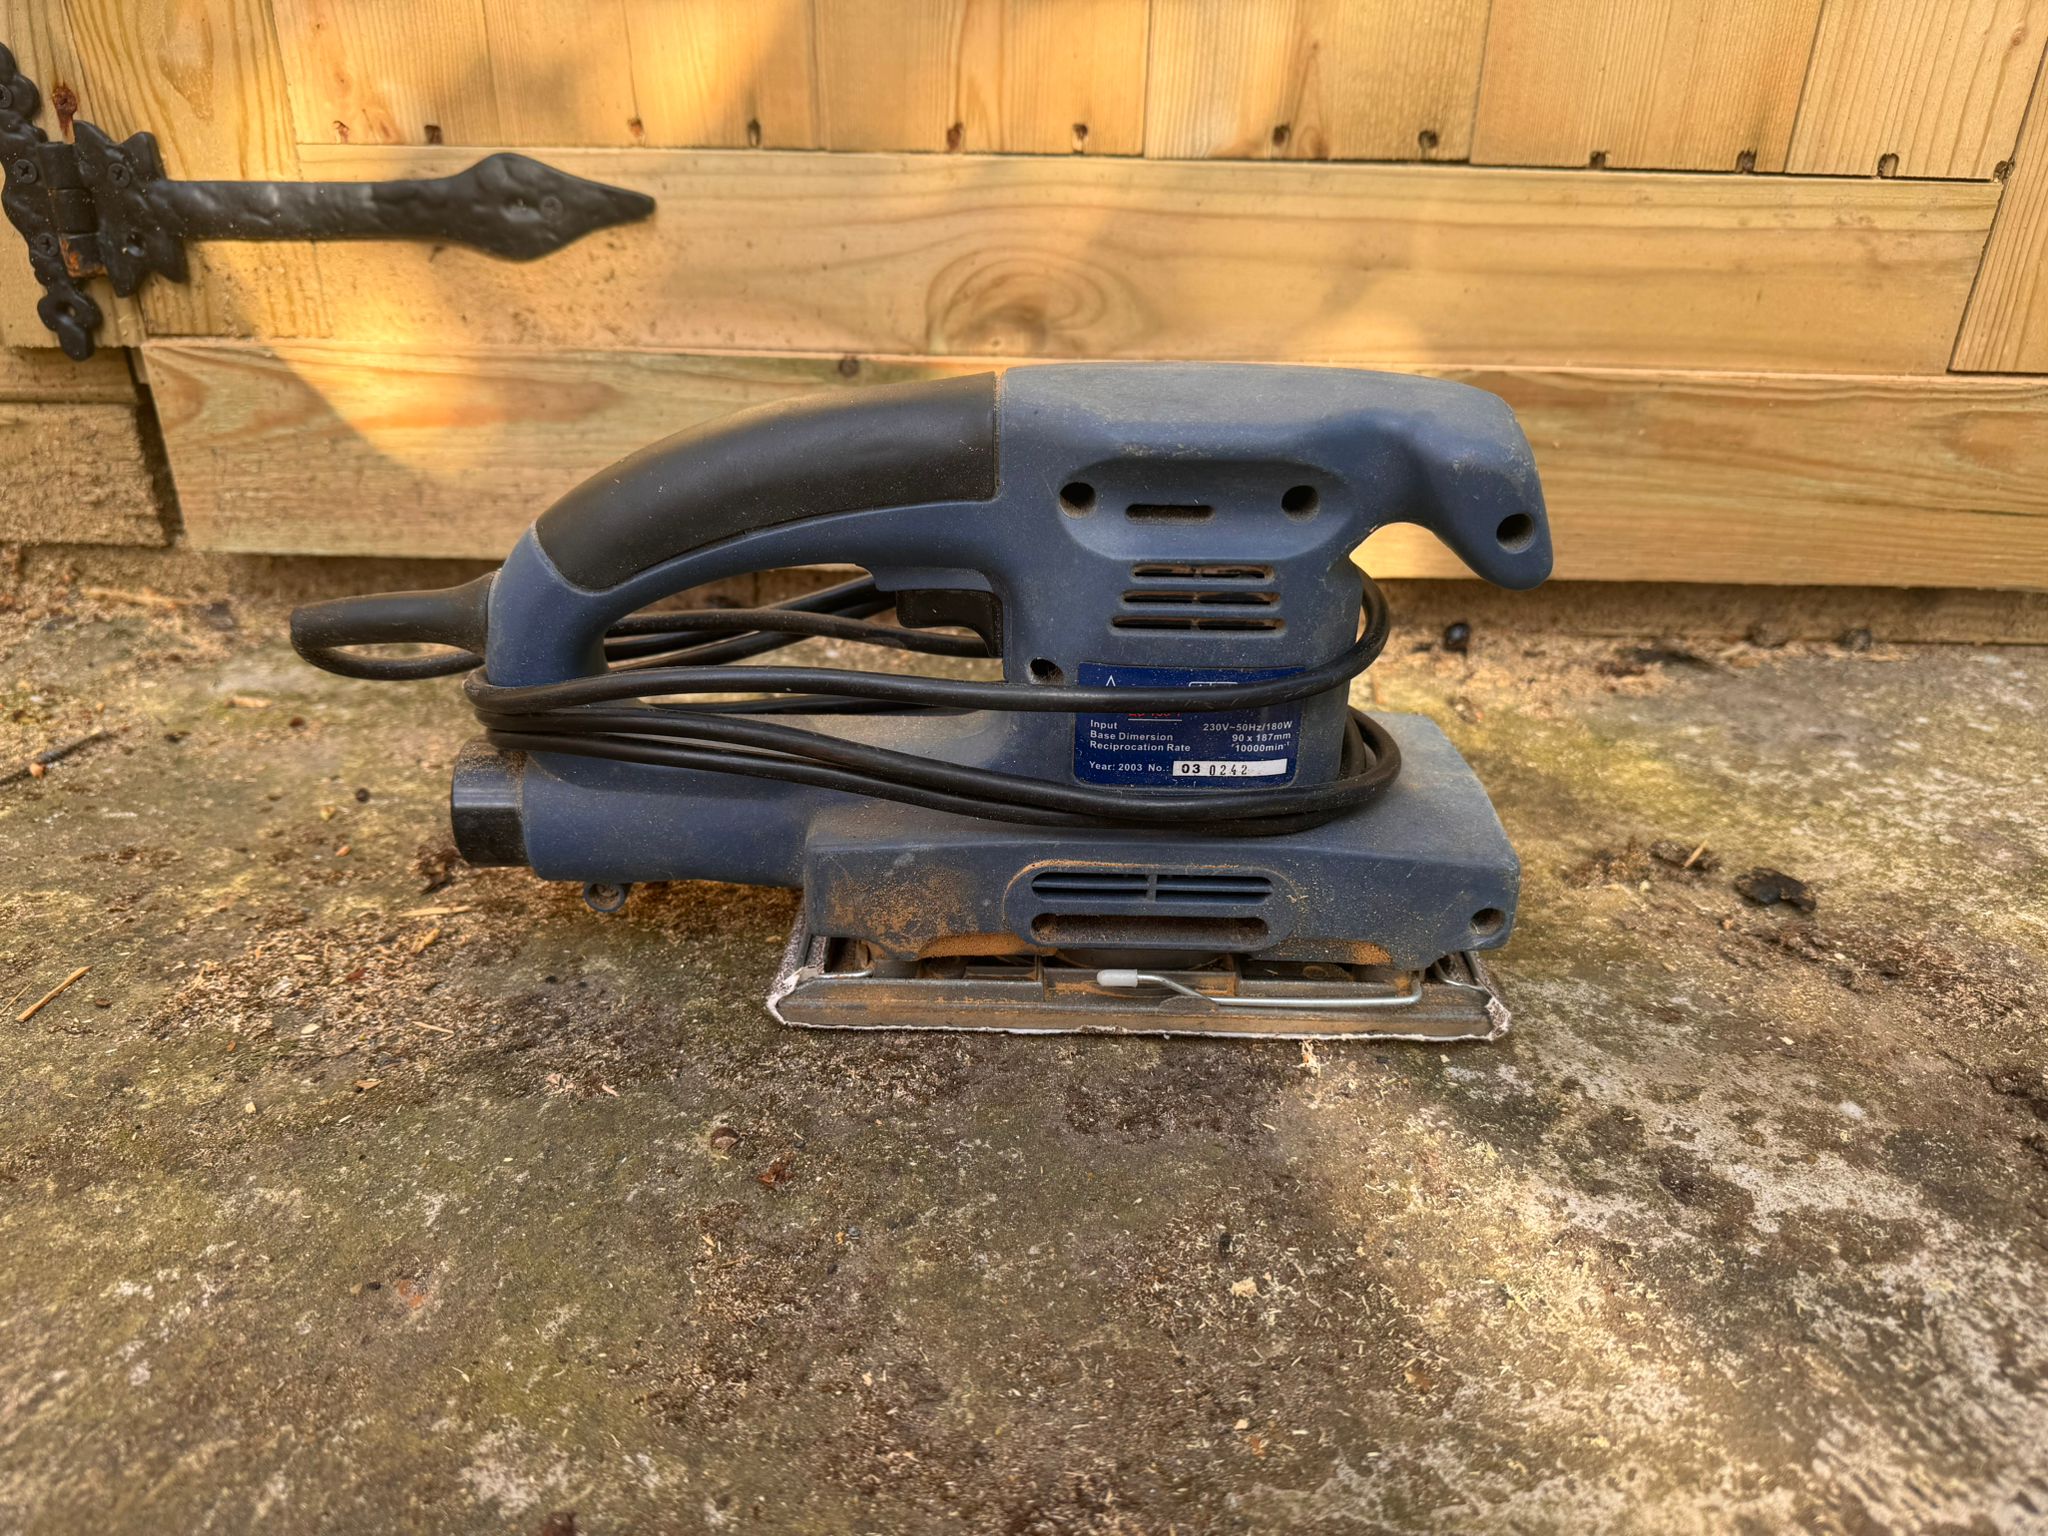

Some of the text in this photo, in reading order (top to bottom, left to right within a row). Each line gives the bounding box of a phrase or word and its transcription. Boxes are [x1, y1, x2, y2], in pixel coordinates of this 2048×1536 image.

[1089, 719, 1118, 730] Input
[1090, 729, 1116, 740] Base
[1231, 734, 1245, 742] 90
[1256, 732, 1292, 742] 187mm
[1089, 740, 1164, 752] Reciprocation
[1166, 743, 1191, 752] Rate
[1088, 760, 1116, 771] Year:
[1118, 763, 1143, 772] 2003
[1181, 763, 1201, 774] 03
